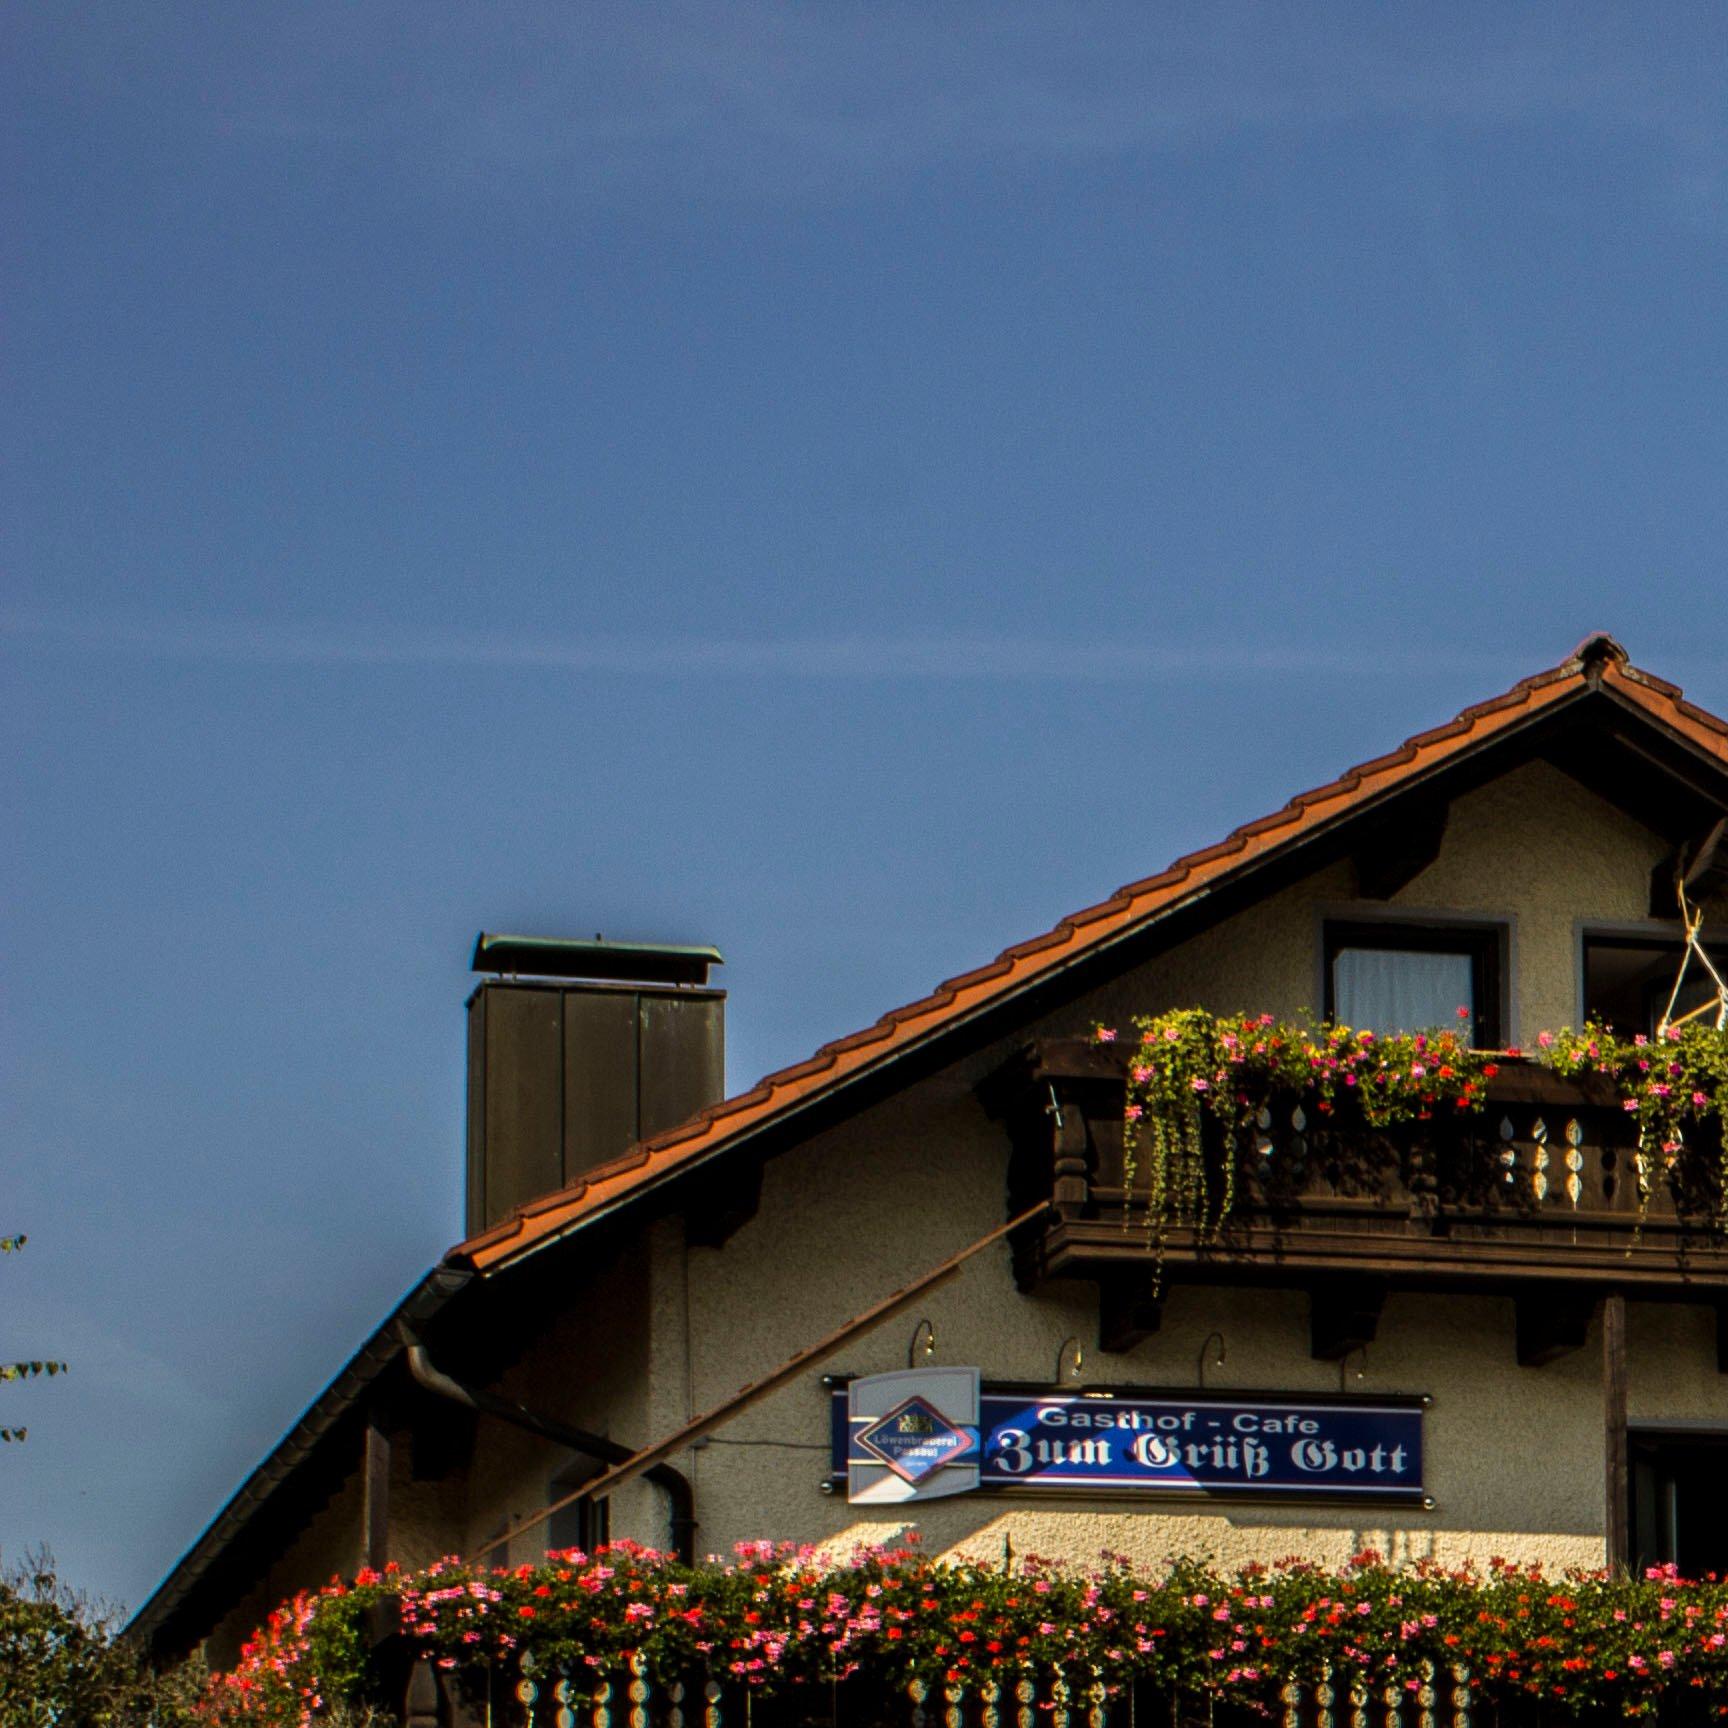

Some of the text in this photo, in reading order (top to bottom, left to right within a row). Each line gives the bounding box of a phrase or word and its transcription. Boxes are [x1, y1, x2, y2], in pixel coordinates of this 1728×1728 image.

[1036, 1406, 1196, 1430] Gasthof
[1232, 1413, 1320, 1434] Cafe
[993, 1428, 1408, 1479] Zum Grüß Gott
